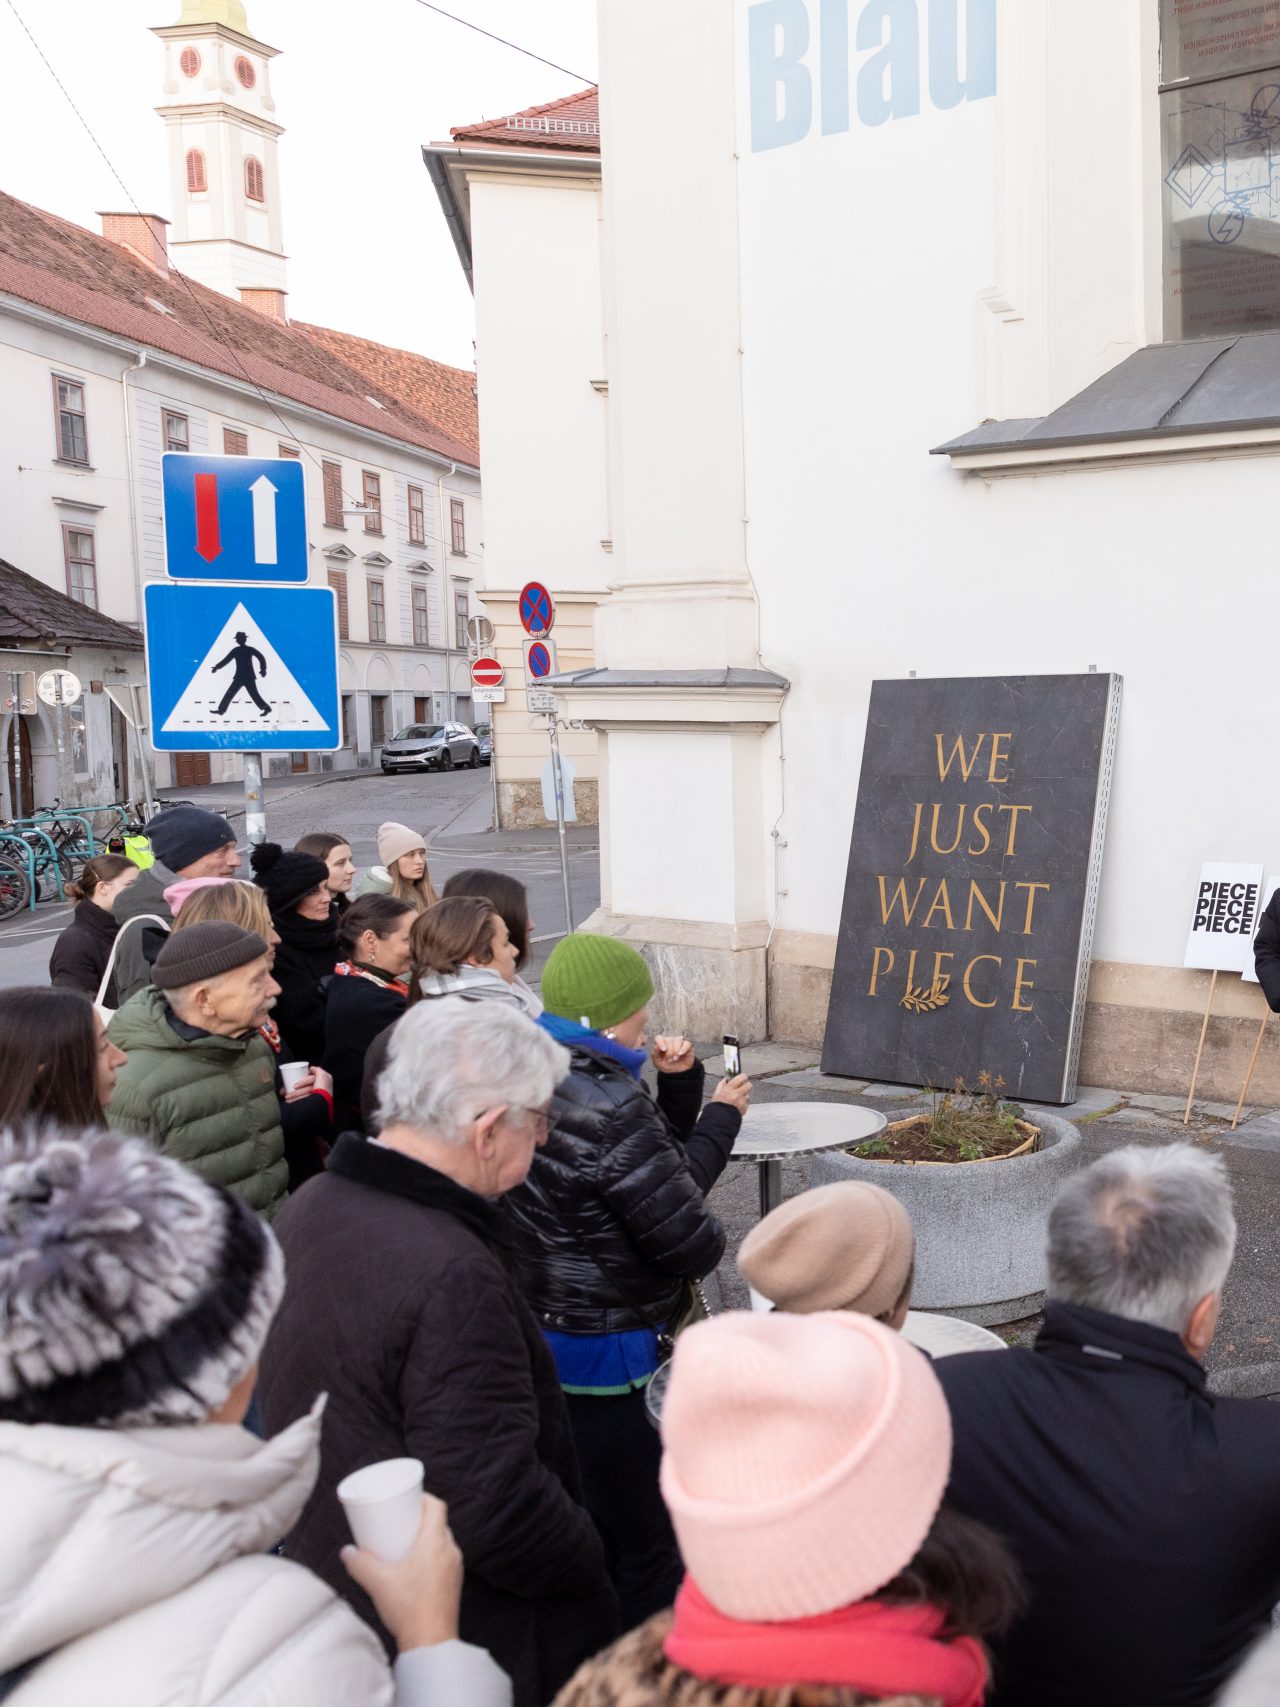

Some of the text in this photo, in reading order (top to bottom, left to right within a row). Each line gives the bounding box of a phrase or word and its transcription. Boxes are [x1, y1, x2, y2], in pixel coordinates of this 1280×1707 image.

[748, 0, 997, 153] Blau
[934, 732, 1012, 783] WE
[905, 802, 1033, 867] JUST
[876, 875, 1050, 935] WANT
[1195, 899, 1256, 918] PIECE
[1199, 881, 1258, 900] PIECE
[1192, 915, 1253, 935] PIECE
[867, 946, 1039, 1012] PIECE
